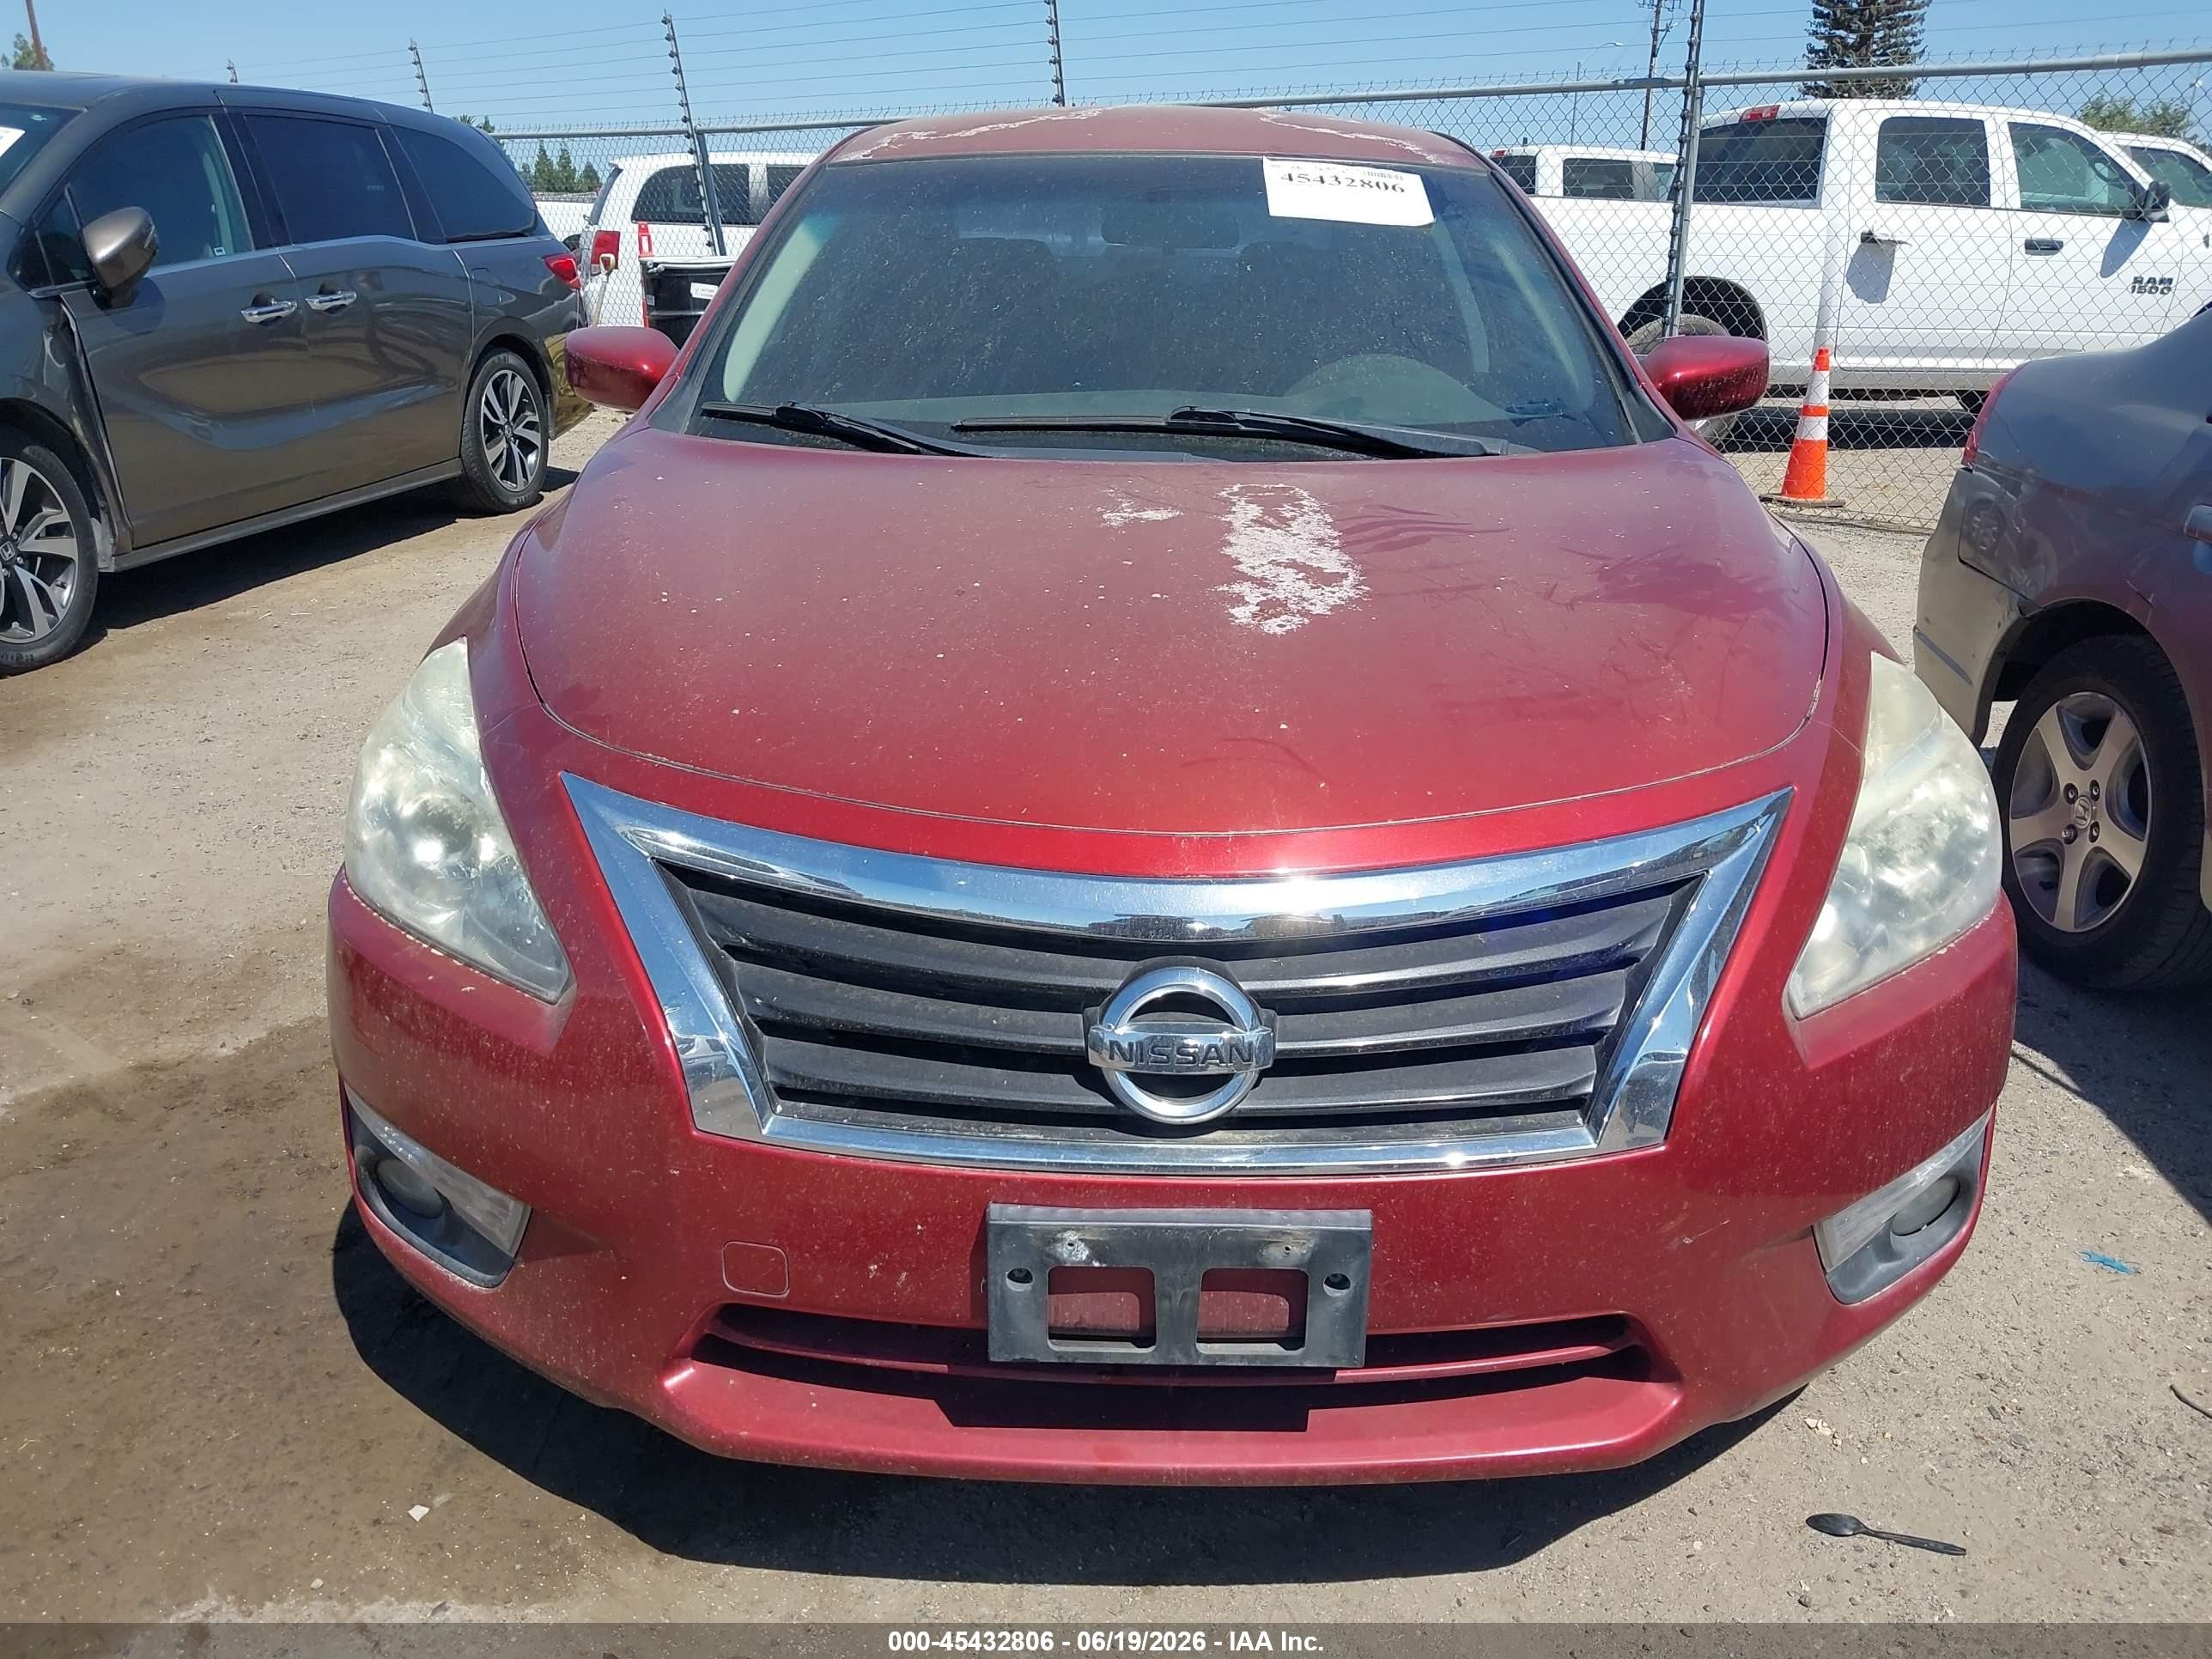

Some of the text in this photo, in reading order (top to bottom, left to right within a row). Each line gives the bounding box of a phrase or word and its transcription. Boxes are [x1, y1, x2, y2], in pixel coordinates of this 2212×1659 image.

[1280, 172, 1406, 193] 45432806
[2131, 276, 2173, 286] RAM
[2130, 284, 2172, 295] 1500
[1108, 1038, 1255, 1067] NISSAN
